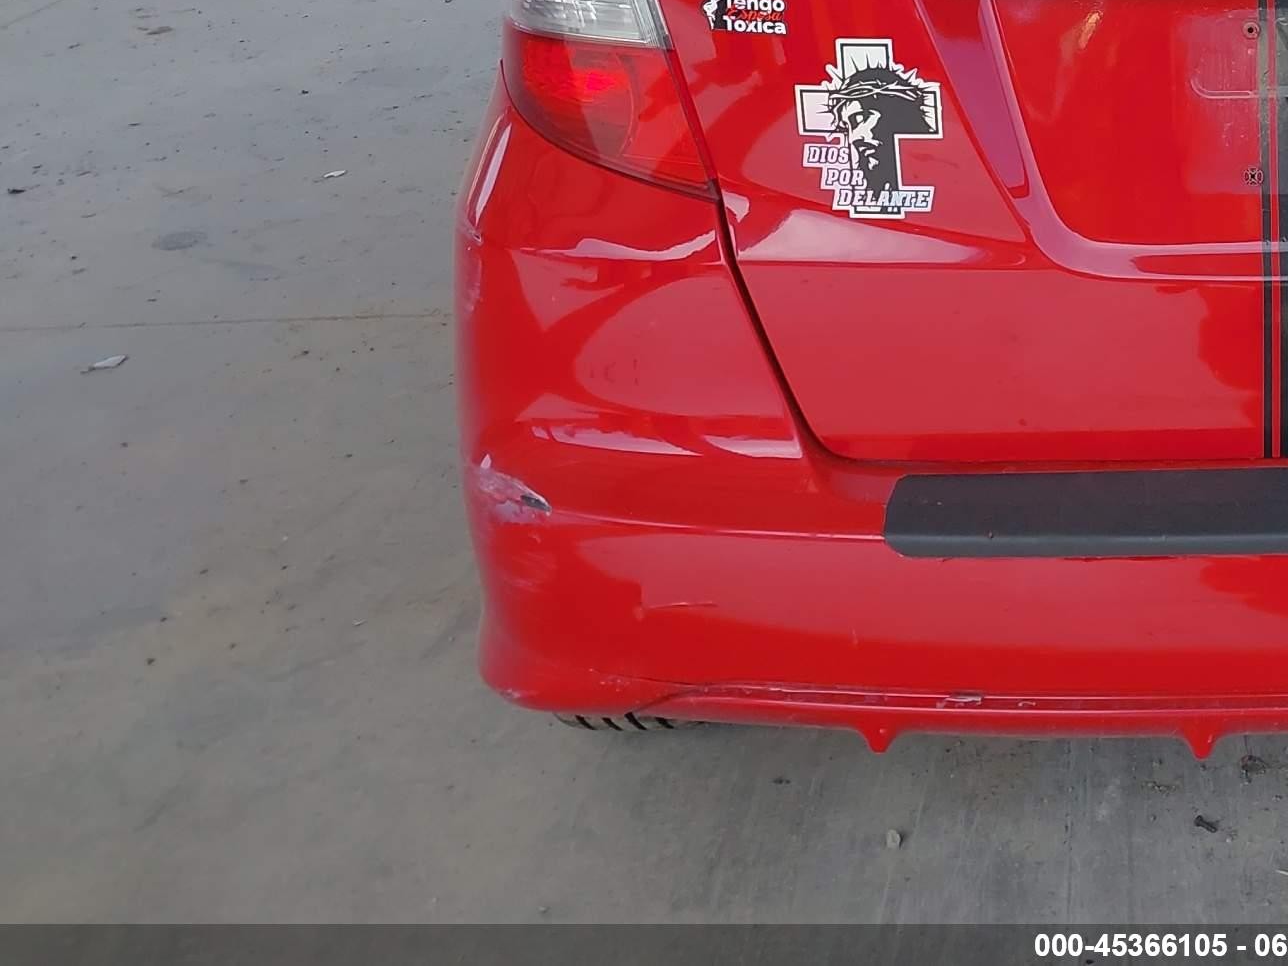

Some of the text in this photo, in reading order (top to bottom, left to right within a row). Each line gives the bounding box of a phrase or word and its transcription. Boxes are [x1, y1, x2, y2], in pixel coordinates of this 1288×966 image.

[807, 146, 850, 165] DIOS
[826, 168, 866, 187] POR
[838, 188, 931, 209] DELANTE
